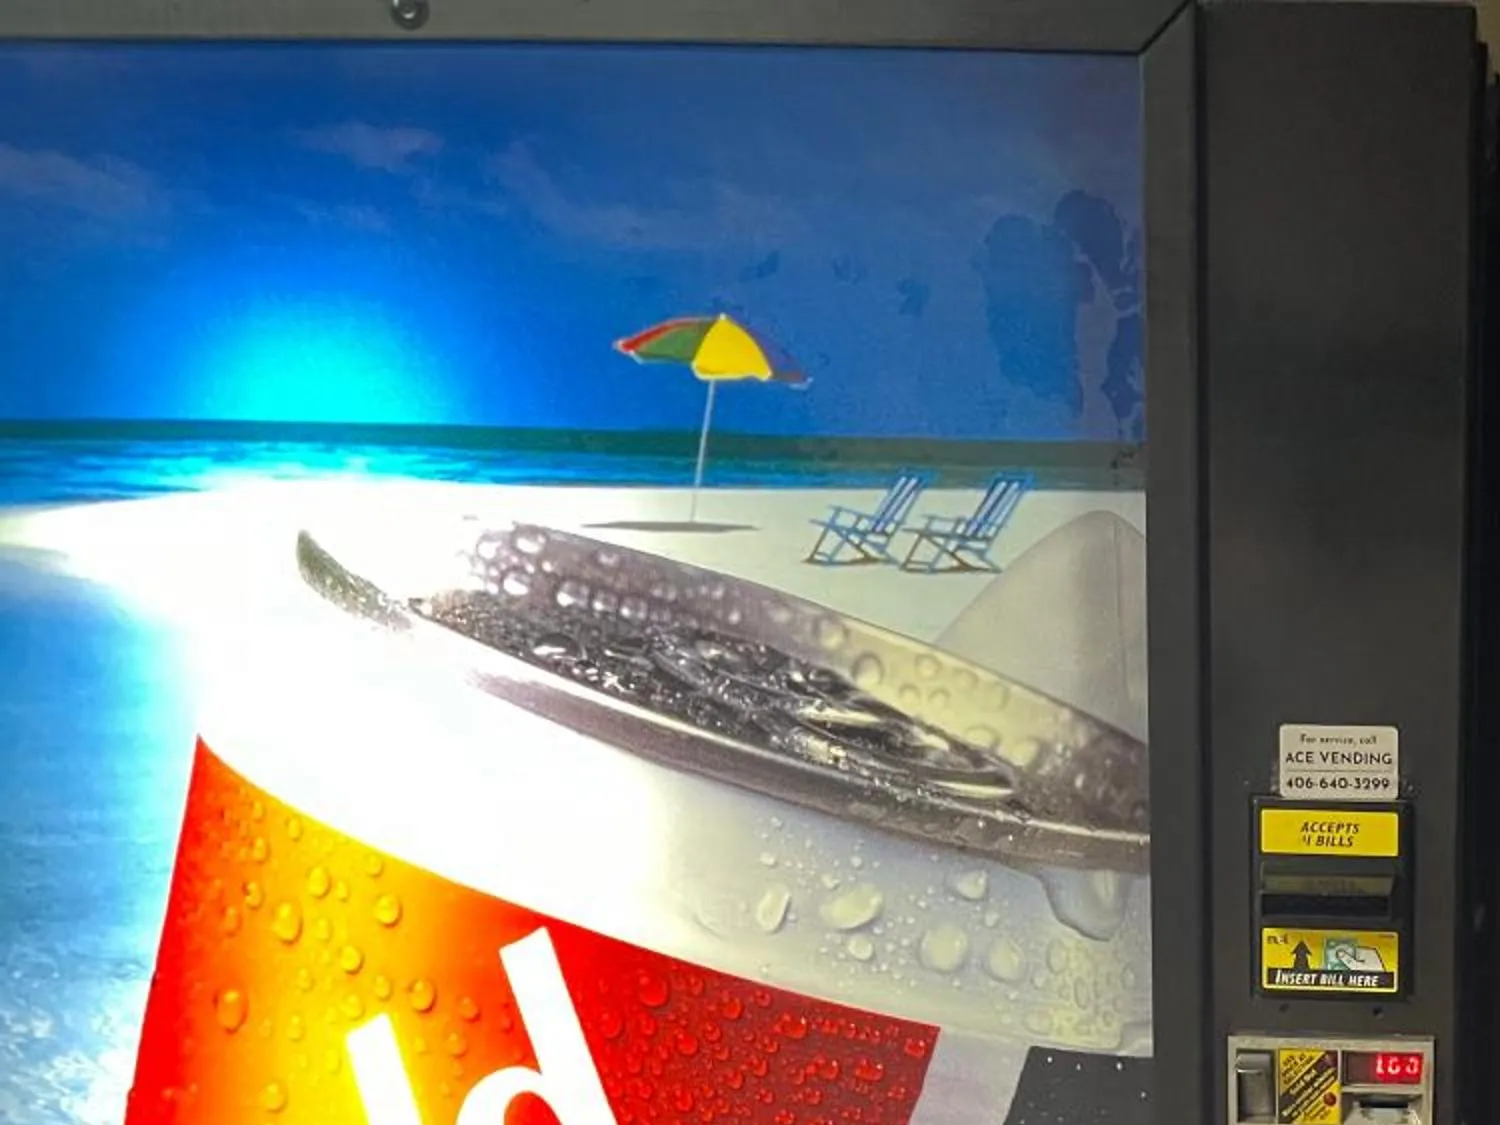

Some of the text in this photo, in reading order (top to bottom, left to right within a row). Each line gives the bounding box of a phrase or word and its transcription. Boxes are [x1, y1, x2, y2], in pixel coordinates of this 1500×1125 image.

[1285, 752, 1393, 765] ACE VENDING
[1286, 777, 1390, 790] 406-640-3299
[1300, 822, 1360, 834] ACCEPTS
[1316, 836, 1354, 847] BILLS
[1349, 974, 1380, 987] HERE
